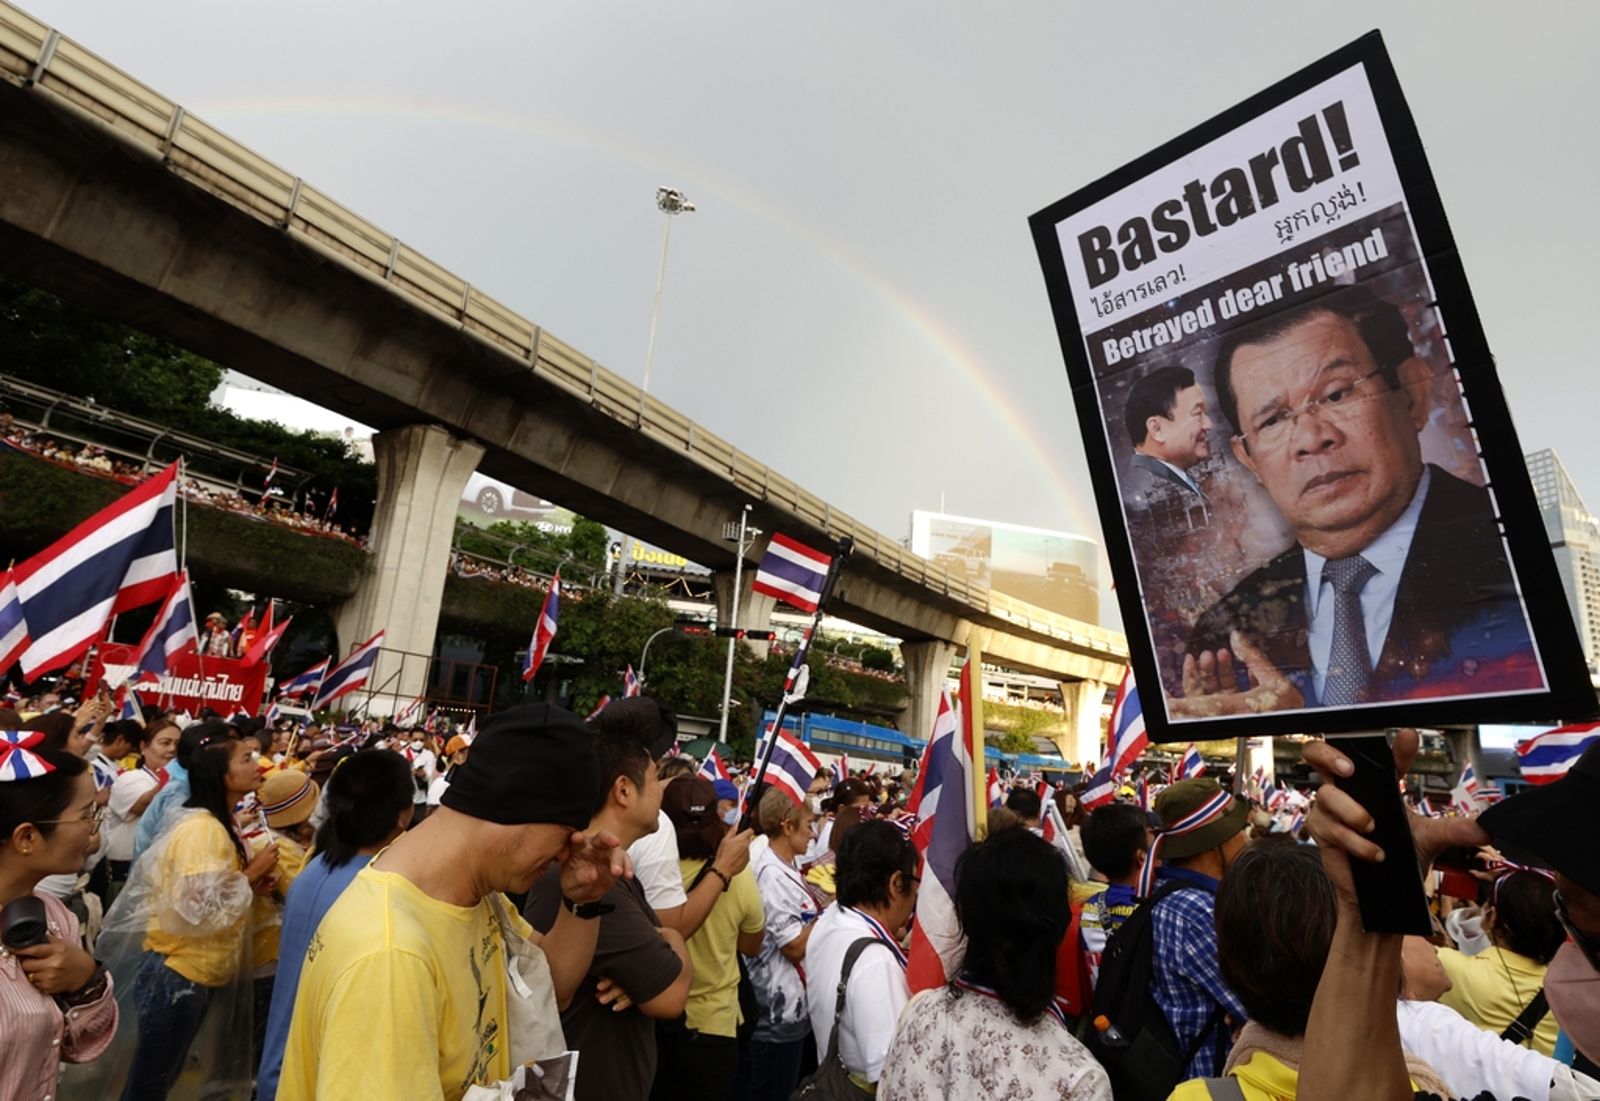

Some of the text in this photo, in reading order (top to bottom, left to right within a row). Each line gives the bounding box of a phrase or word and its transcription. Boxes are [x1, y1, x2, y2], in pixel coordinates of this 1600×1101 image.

[1077, 100, 1361, 289] Bastard!
[1089, 264, 1186, 317] ไอ้สารเลว!
[1102, 227, 1389, 366] Betrayed dear friend
